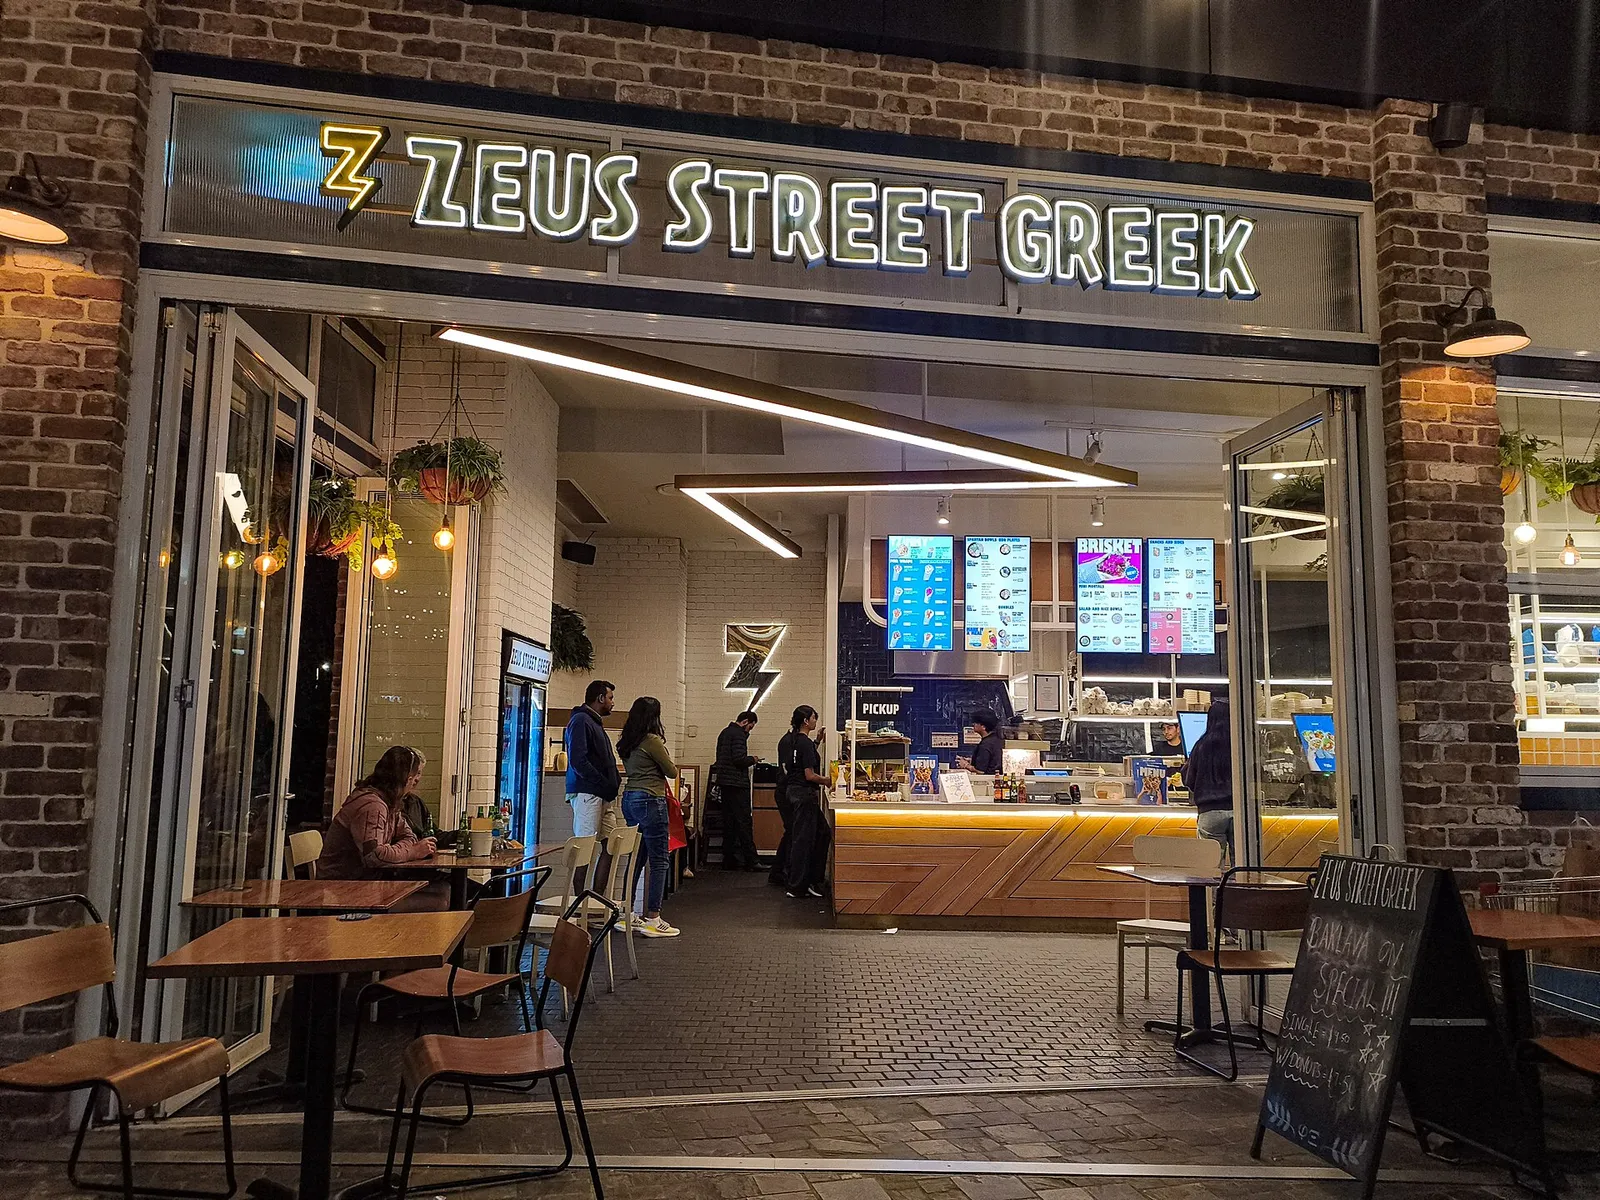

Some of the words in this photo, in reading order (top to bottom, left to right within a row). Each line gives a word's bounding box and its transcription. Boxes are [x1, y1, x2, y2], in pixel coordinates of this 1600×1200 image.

[405, 134, 639, 246] ZEUS
[663, 158, 985, 277] STREET
[999, 192, 1259, 300] GREEK
[1080, 538, 1141, 554] BRISKET
[862, 703, 900, 715] PICKUP
[910, 759, 936, 769] MENU
[1139, 766, 1166, 778] MENU
[1313, 859, 1347, 901] ZEUS
[1345, 861, 1385, 906] STREET
[1381, 866, 1424, 911] GREEK
[1306, 916, 1370, 962] BAKLAVA
[1379, 940, 1404, 967] ON
